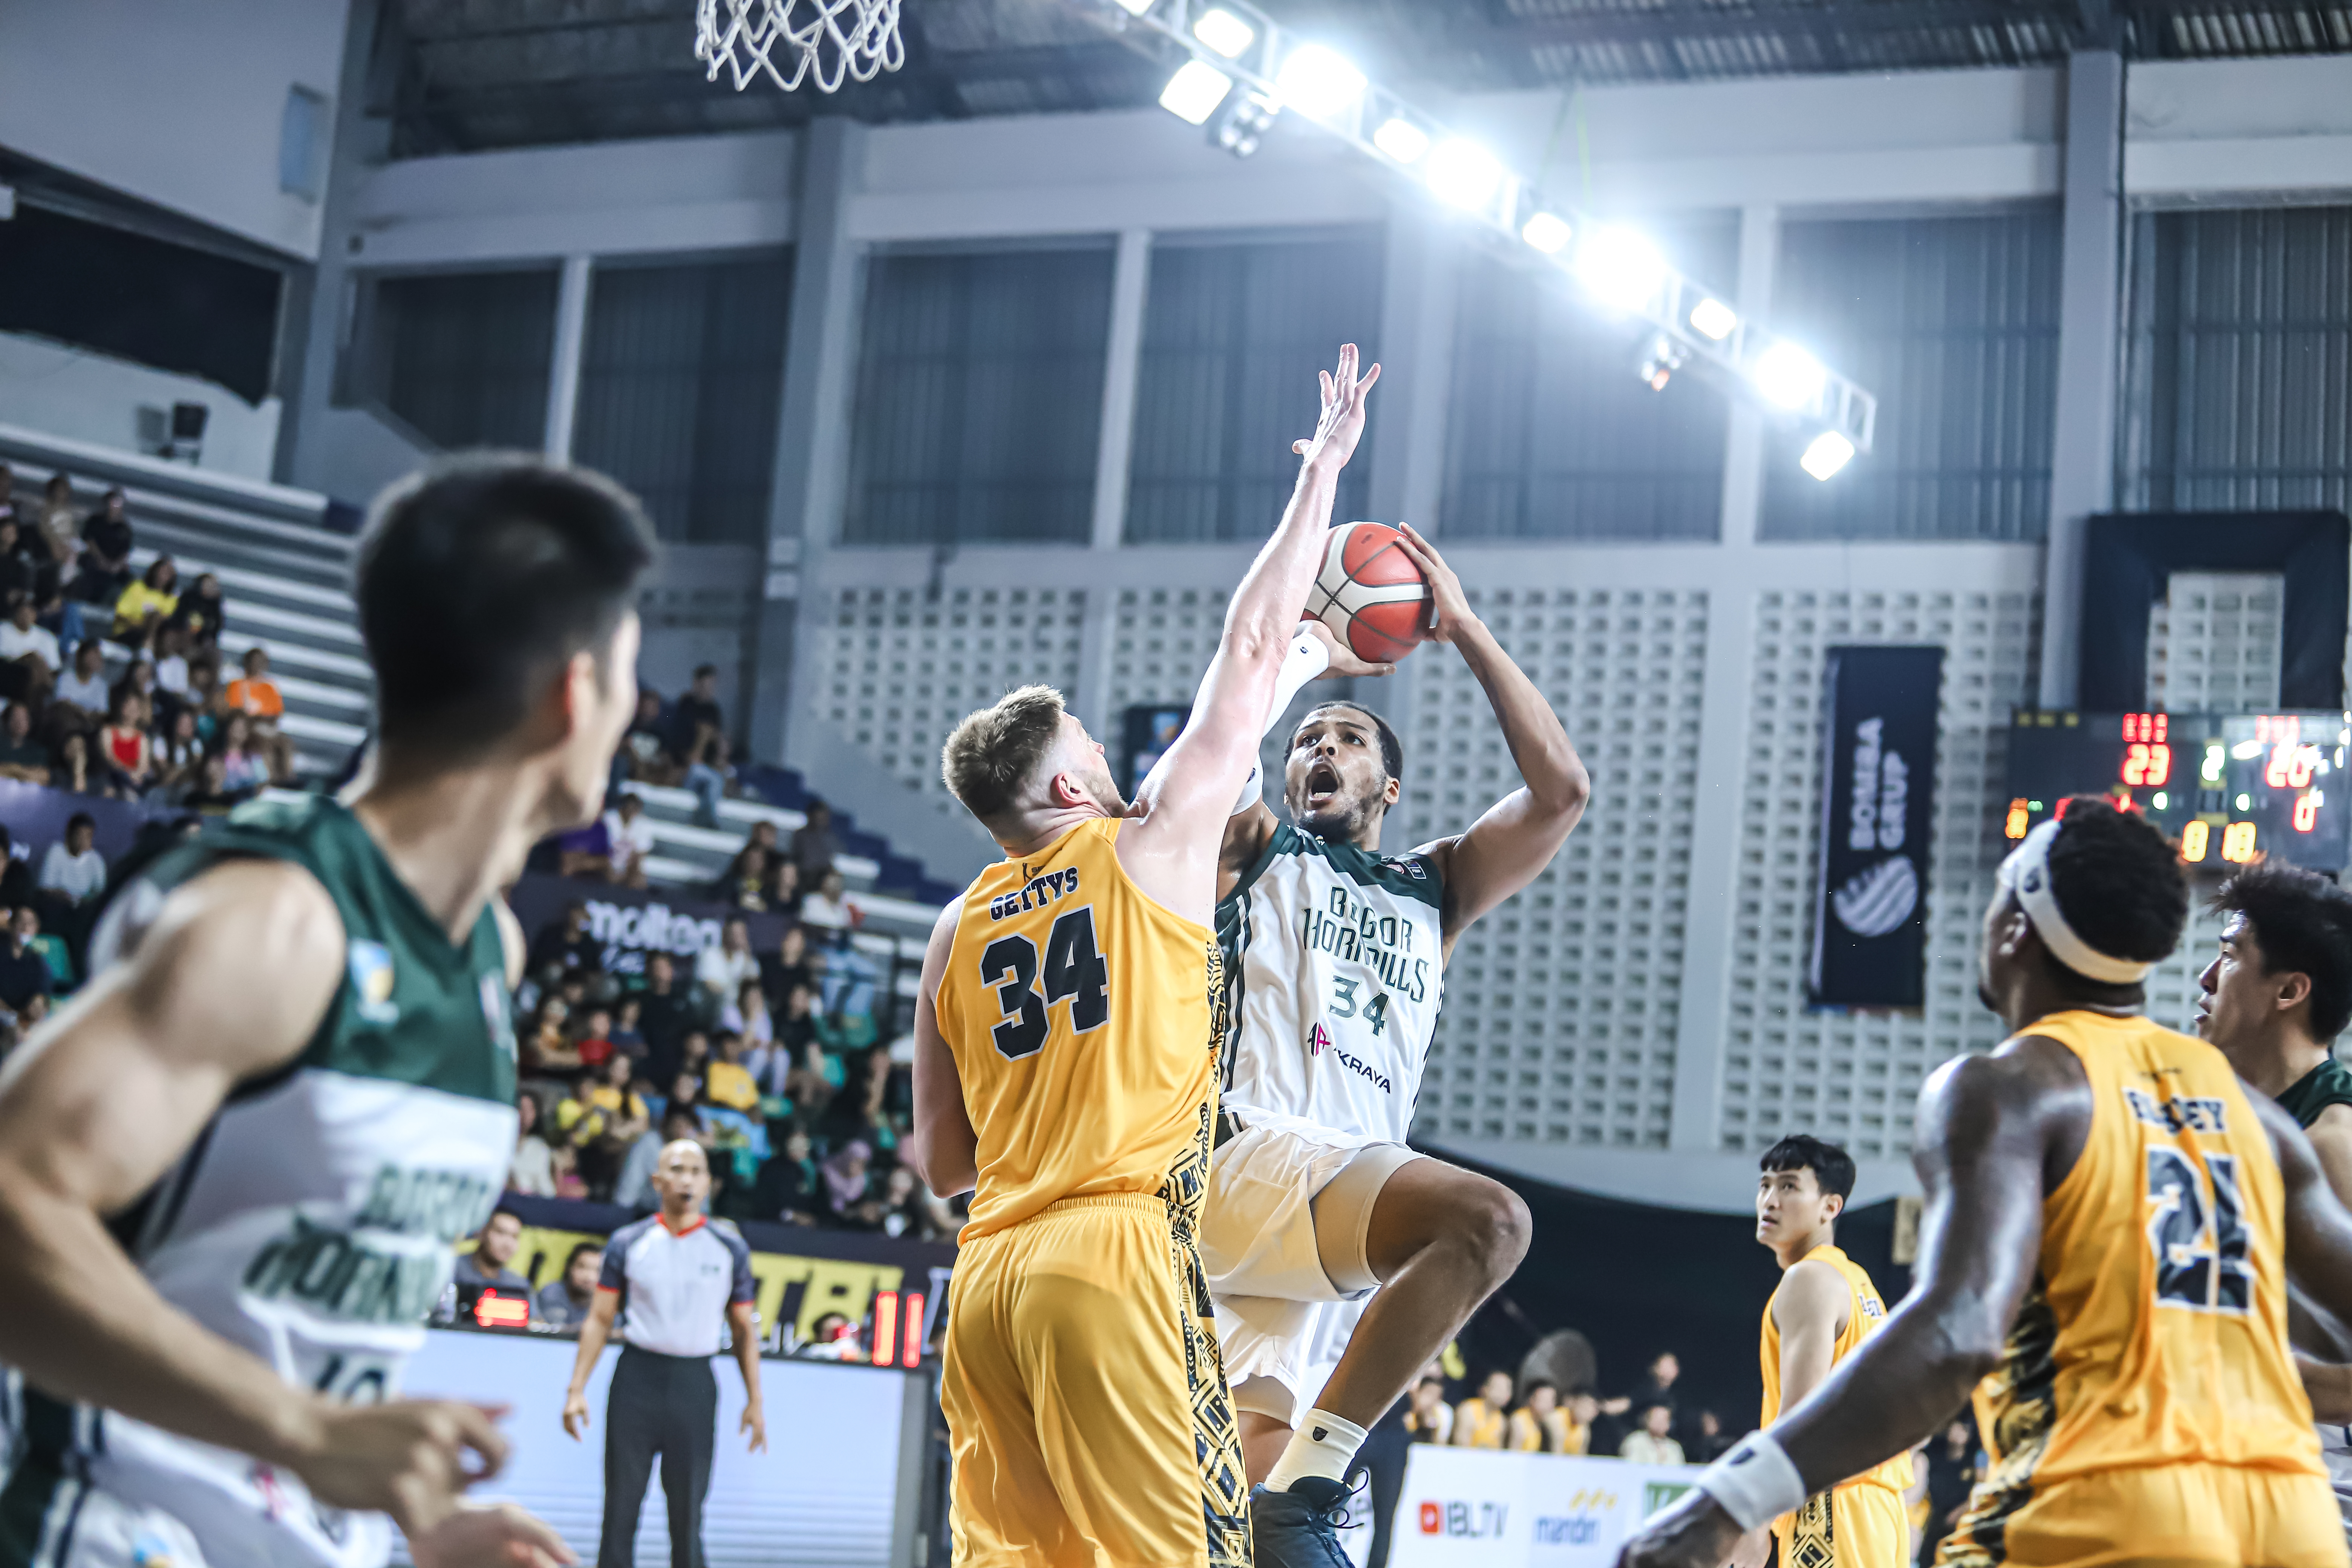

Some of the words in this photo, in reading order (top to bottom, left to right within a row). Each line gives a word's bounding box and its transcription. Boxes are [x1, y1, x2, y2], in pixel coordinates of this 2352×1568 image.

[2122, 743, 2170, 785] 23
[989, 866, 1080, 922] GETTYS
[979, 903, 1111, 1063] 34
[1328, 972, 1390, 1039] 34
[1333, 1047, 1390, 1094] KRAYA
[2146, 1143, 2256, 1316] 21
